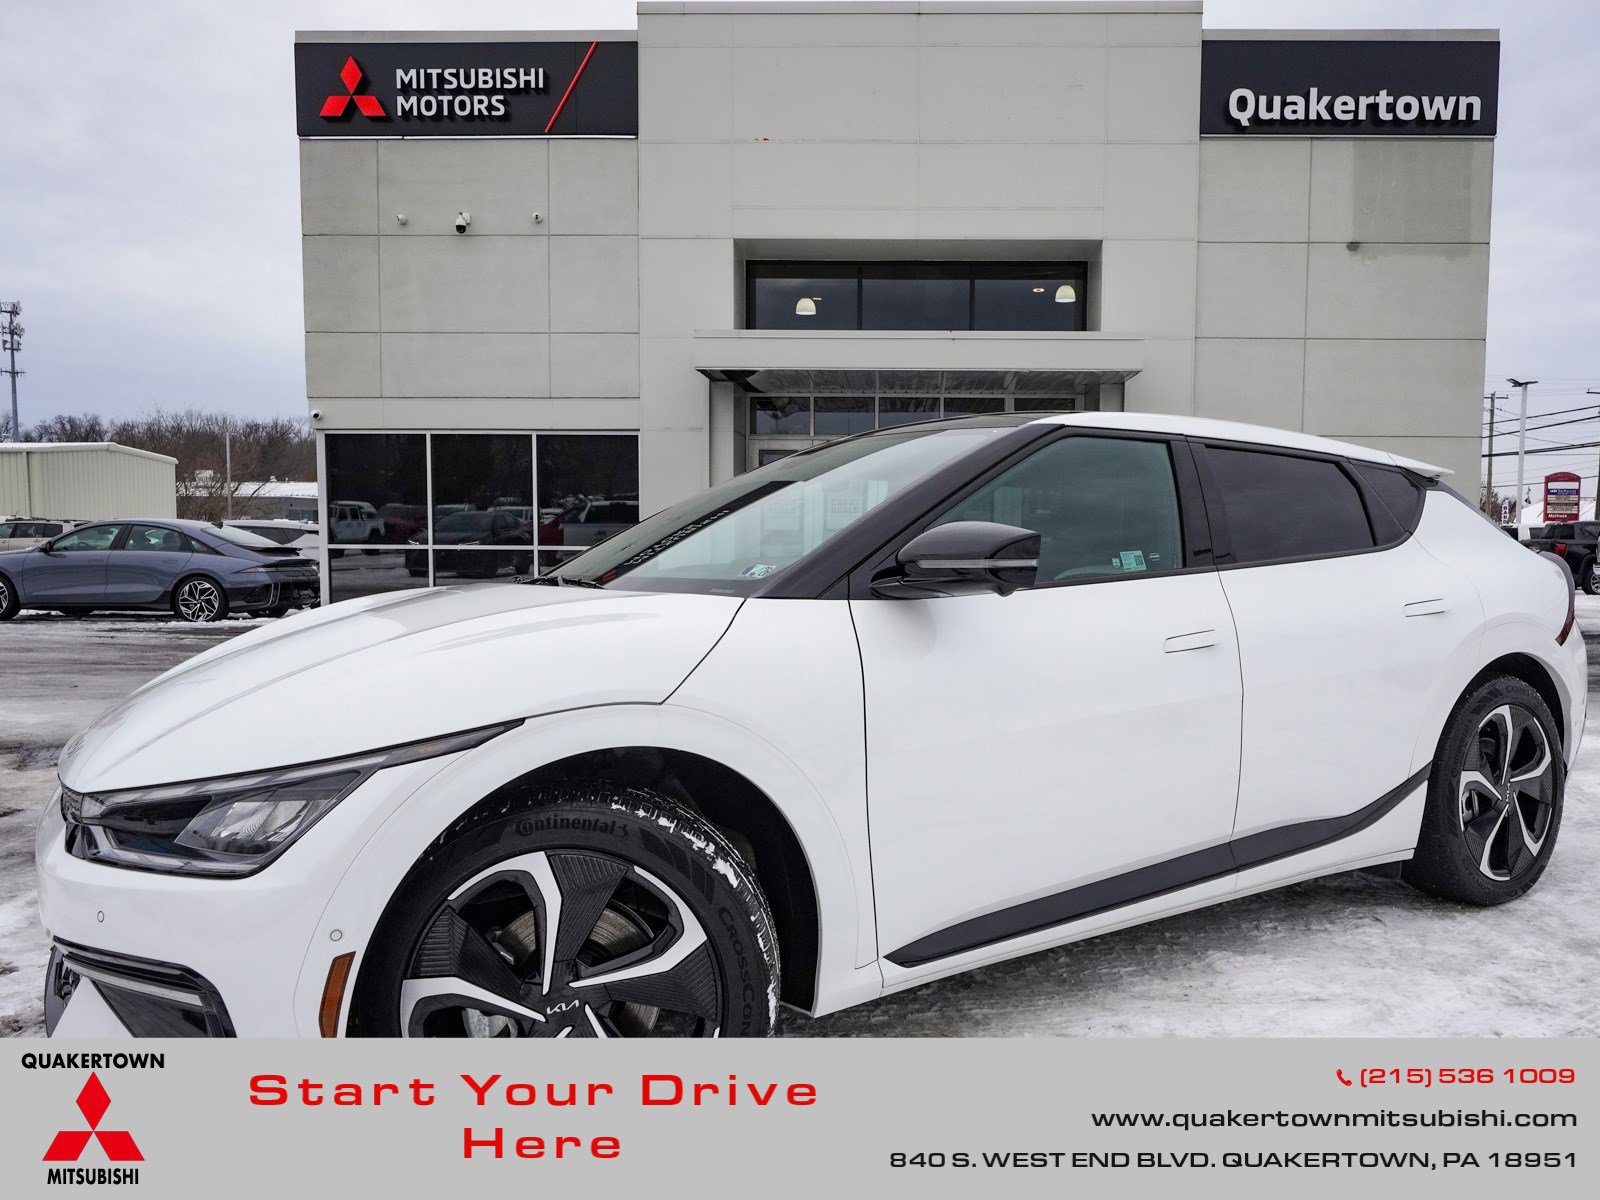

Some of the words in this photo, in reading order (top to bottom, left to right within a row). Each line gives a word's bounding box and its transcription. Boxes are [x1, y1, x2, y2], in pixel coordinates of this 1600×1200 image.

[396, 67, 544, 90] MITSUBISHI
[396, 94, 506, 117] MOTORS
[1228, 87, 1482, 127] Quakertown
[515, 813, 615, 838] Continental
